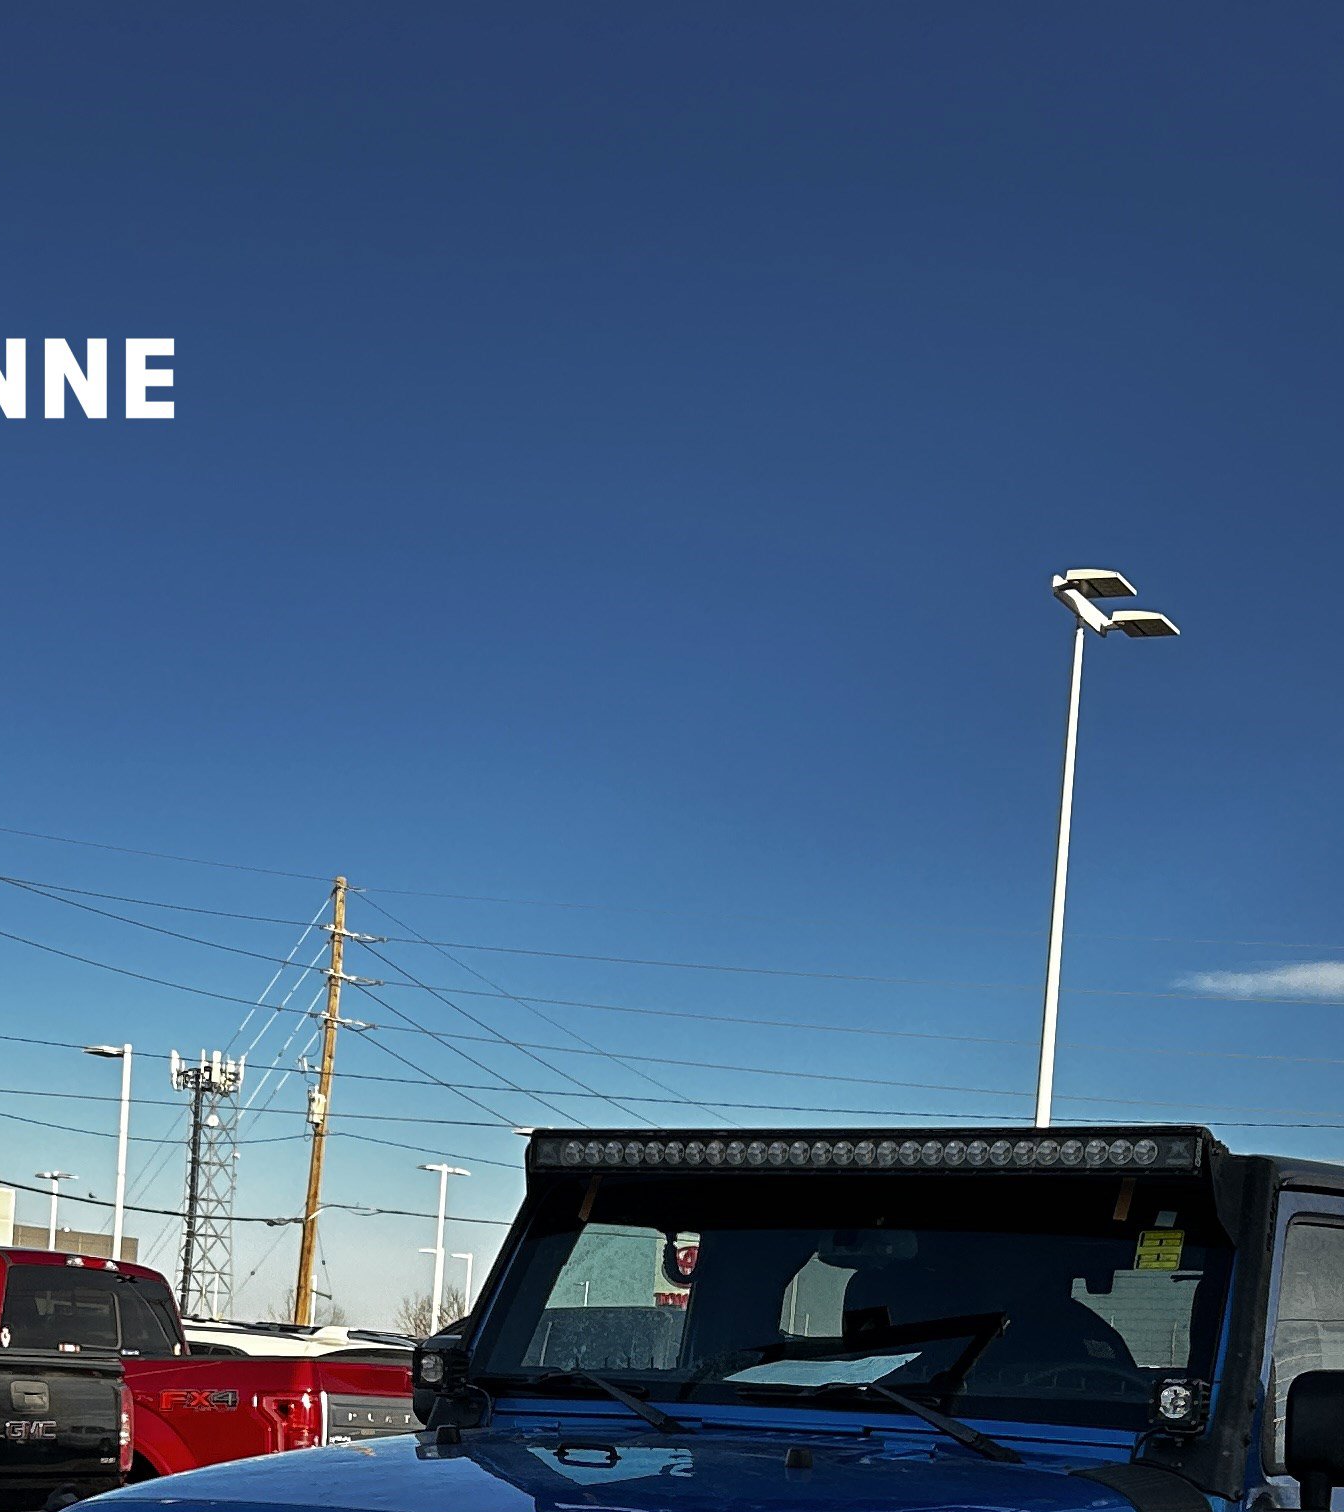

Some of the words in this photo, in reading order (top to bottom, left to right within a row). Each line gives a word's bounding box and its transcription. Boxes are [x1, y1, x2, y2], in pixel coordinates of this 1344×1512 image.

[159, 1388, 239, 1412] FX4
[347, 1412, 411, 1424] PLAT
[5, 1420, 57, 1440] GMC
